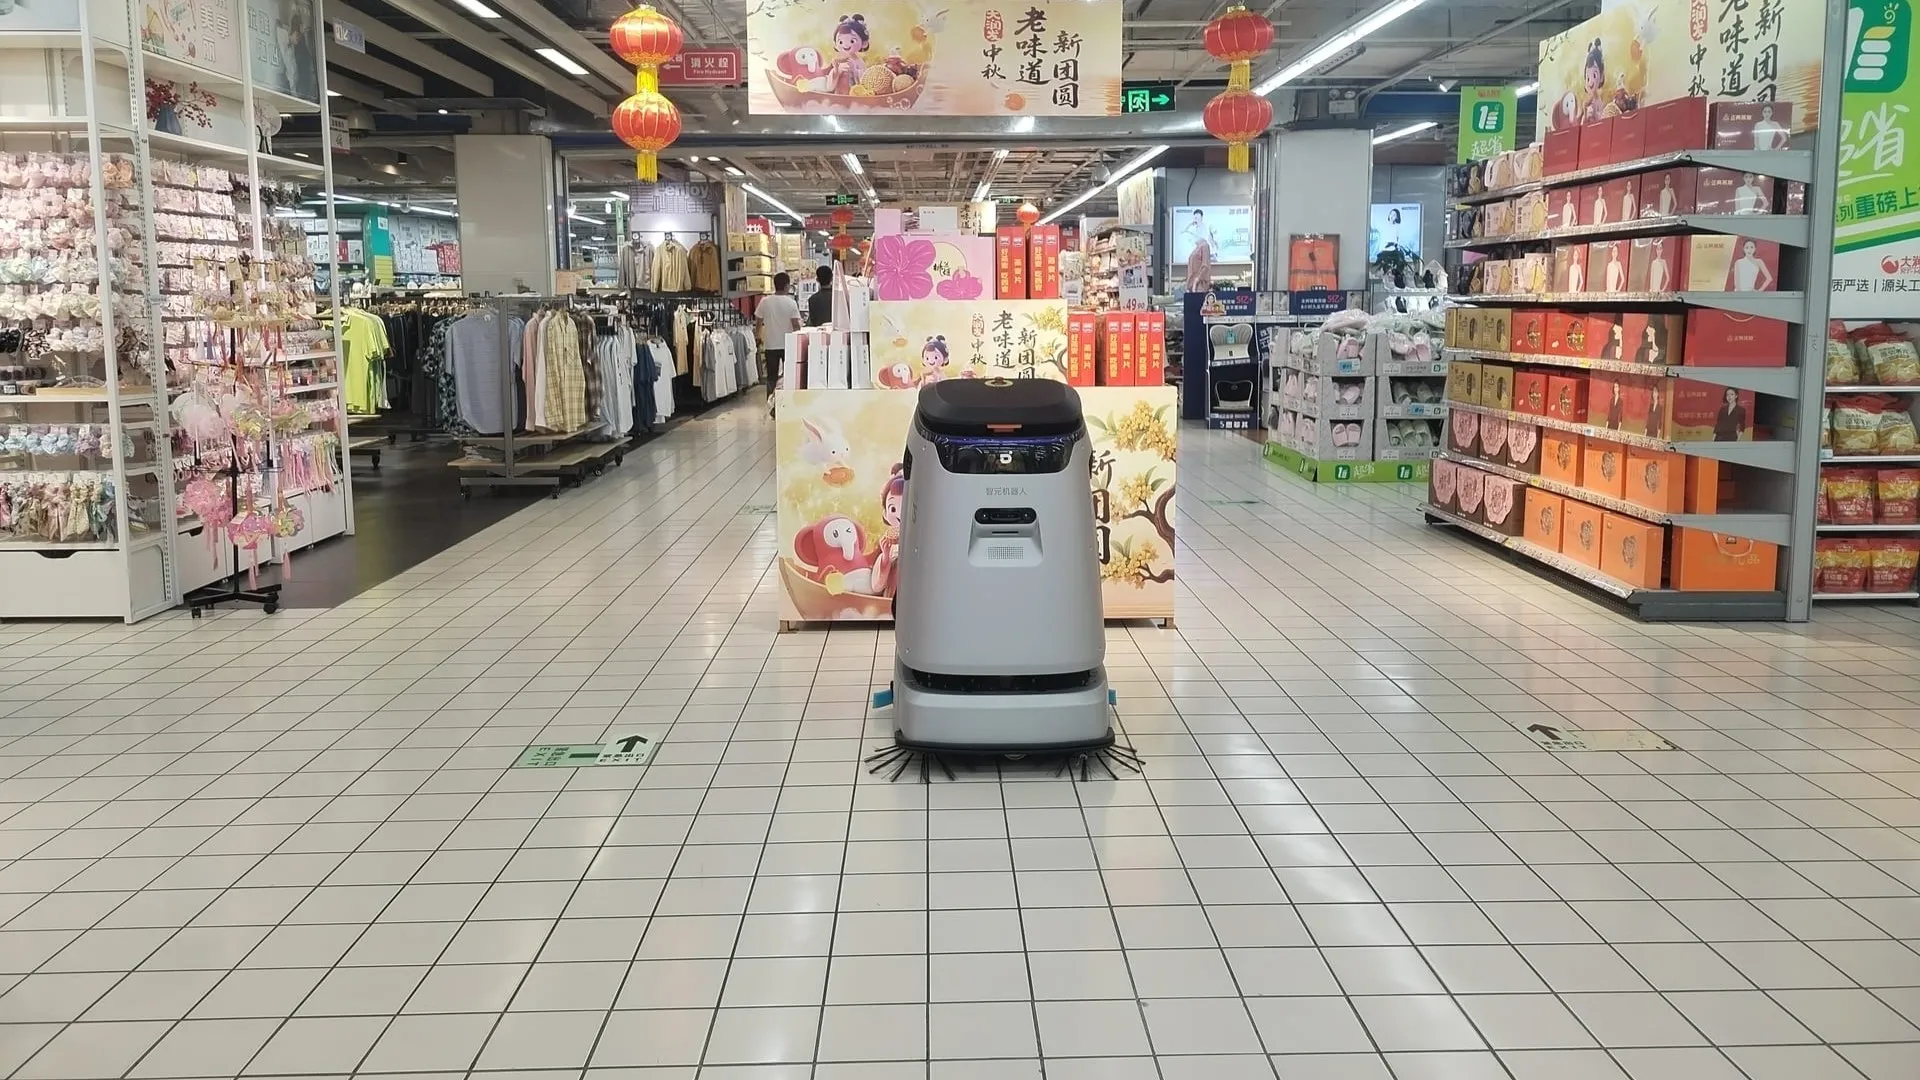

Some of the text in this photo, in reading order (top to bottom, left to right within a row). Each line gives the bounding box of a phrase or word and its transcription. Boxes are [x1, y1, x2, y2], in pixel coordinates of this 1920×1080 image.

[690, 57, 729, 69] 消火栓
[981, 44, 1006, 80] 中秋
[1014, 6, 1050, 85] 老味道
[1053, 30, 1083, 108] 新团圆
[1688, 44, 1709, 97] 中秋
[970, 338, 987, 366] 中秋
[992, 310, 1016, 368] 老味道
[985, 487, 1028, 496] 智元机器人
